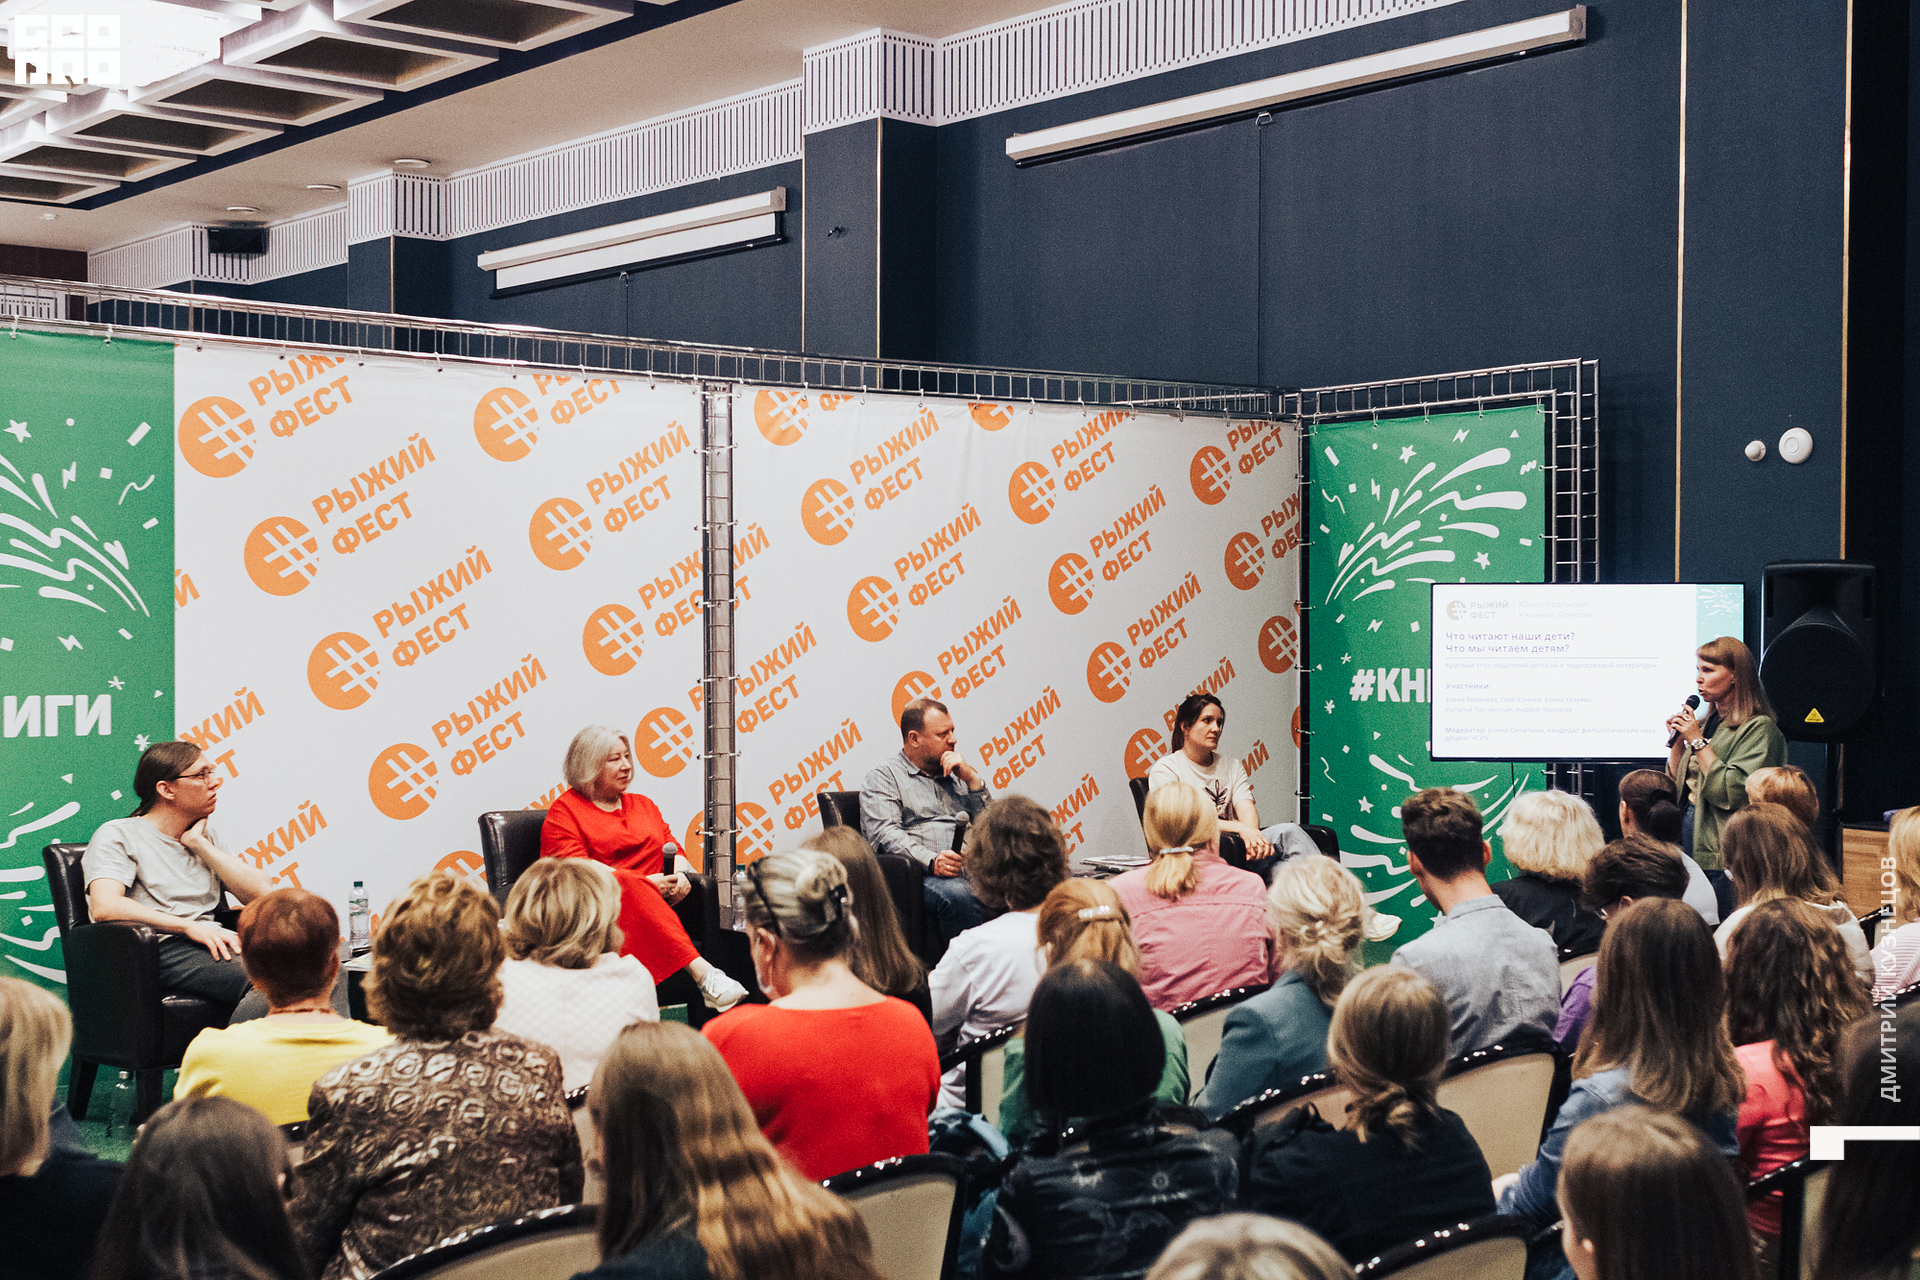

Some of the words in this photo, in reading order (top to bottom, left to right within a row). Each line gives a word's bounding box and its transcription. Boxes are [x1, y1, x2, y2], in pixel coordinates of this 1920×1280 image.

[249, 354, 345, 407] РЫЖ
[270, 376, 353, 438] ФЕСТ
[587, 421, 691, 505] РЫЖИЙ
[850, 407, 940, 485] РЫЖИЙ
[1064, 442, 1115, 492] ФЕСТ
[1239, 427, 1283, 475] ФЕСТ
[312, 433, 436, 525] РЫЖИЙ
[604, 475, 671, 533] ФЕСТ
[865, 457, 923, 511] ФЕСТ
[333, 492, 412, 555] ФЕСТ
[894, 503, 982, 582] РЫЖИЙ
[1090, 484, 1167, 559] РЫЖИЙ
[909, 552, 965, 607] ФЕСТ
[1102, 531, 1152, 582] ФЕСТ
[373, 545, 493, 639] РЫЖИЙ
[1127, 572, 1202, 647] РЫЖИЙ
[1470, 600, 1509, 609] РЫЖИЙ
[1470, 611, 1497, 619] ФЕСТ
[393, 603, 470, 668] ФЕСТ
[937, 596, 1022, 676] РЫЖИЙ
[1139, 618, 1188, 669] ФЕСТ
[1445, 632, 1465, 640] Что
[1544, 632, 1576, 642] дети?
[1445, 644, 1465, 653] Что
[1468, 645, 1485, 653] мы
[1488, 645, 1528, 653] читаем
[1531, 644, 1570, 654] детям?
[432, 654, 547, 749] РЫЖИЙ
[951, 645, 1006, 700] ФЕСТ
[178, 686, 266, 752] ЖИЙ
[736, 675, 799, 734] ФЕСТ
[979, 686, 1062, 767] РЫЖИЙ
[451, 711, 526, 776] ФЕСТ
[769, 718, 863, 806] РЫЖИЙ
[993, 734, 1046, 790] ФЕСТ
